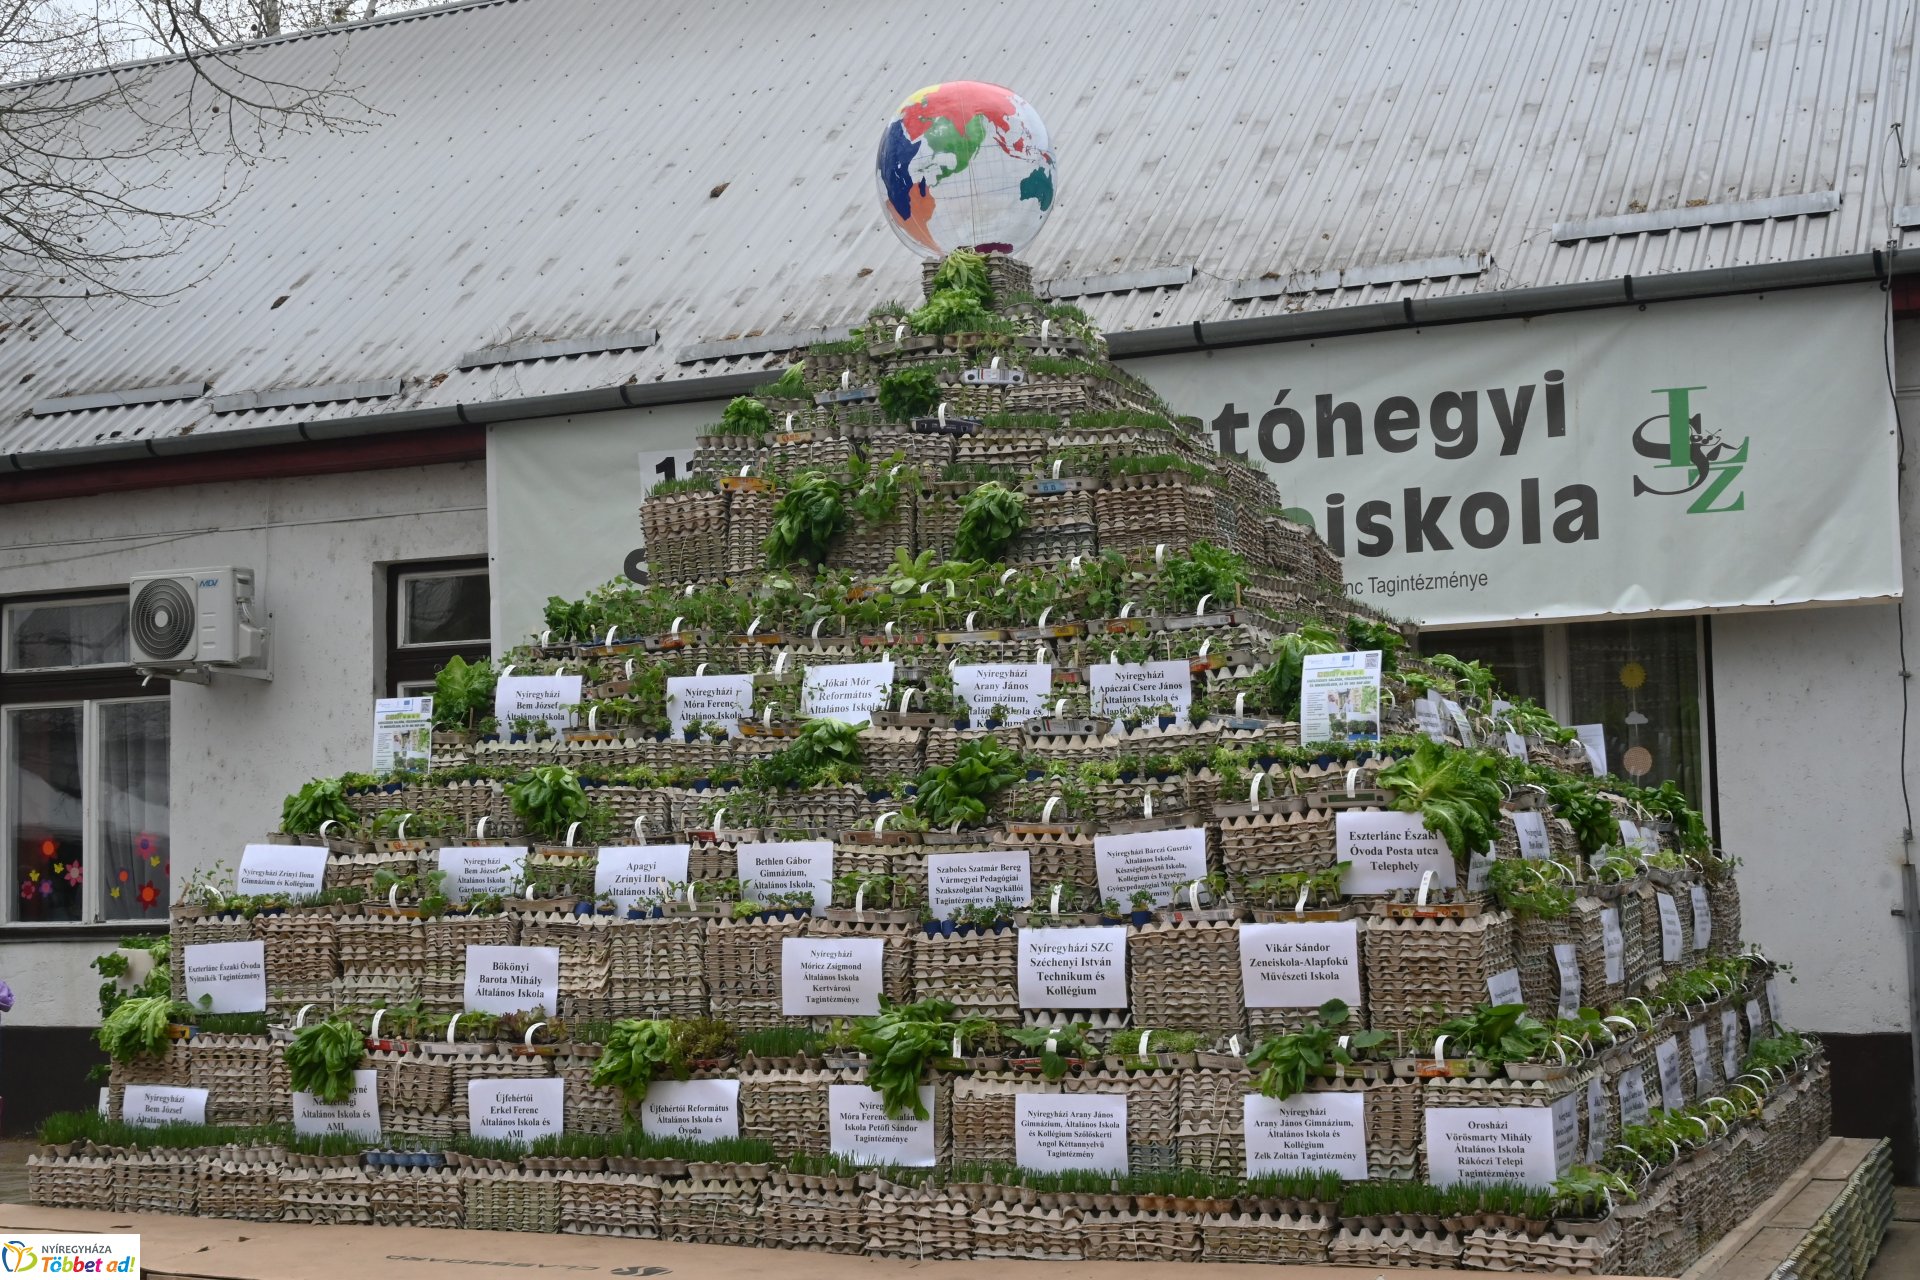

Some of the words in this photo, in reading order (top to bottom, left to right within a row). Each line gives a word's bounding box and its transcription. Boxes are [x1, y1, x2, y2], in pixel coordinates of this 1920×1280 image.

[1186, 369, 1566, 464] tóhegyi
[1281, 474, 1600, 558] iskola
[1367, 570, 1489, 597] Tagintézménye
[977, 669, 1028, 679] Nyíregyházi
[1115, 671, 1164, 682] Nyíregyházi
[823, 677, 848, 687] Jókai
[850, 677, 871, 686] Mór
[974, 682, 999, 691] Arany
[1002, 680, 1029, 689] János
[686, 687, 733, 698] Nyíregyházi
[1099, 683, 1131, 694] Apáczai
[1132, 682, 1157, 691] Csere
[1158, 681, 1183, 690] János
[516, 690, 560, 699] Nyíregyházi
[819, 690, 872, 701] Református
[973, 693, 1029, 703] Gimnázium,
[1143, 693, 1168, 702] Iskola
[1170, 693, 1180, 701] és
[535, 701, 559, 709] József
[684, 700, 705, 709] Móra
[809, 703, 850, 714] Általános
[542, 713, 565, 721] Iskola
[1349, 830, 1402, 841] Eszterlánc
[1107, 849, 1144, 859] Nyíregyházi
[1145, 846, 1166, 856] Bárczi
[1166, 844, 1192, 853] Gusztáv
[1350, 844, 1383, 856] Óvoda
[1385, 846, 1414, 855] Posta
[1416, 847, 1439, 855] utca
[464, 858, 501, 866] Nyíregyházi
[755, 858, 784, 866] Bethlen
[786, 856, 813, 865] Gábor
[1124, 857, 1153, 866] Általános
[626, 862, 656, 872] Apagyi
[936, 866, 967, 874] Szabolcs
[968, 864, 998, 873] Szatmár
[1000, 863, 1022, 872] Bereg
[1369, 861, 1420, 872] Telephely
[243, 868, 277, 878] Nyíregyházi
[278, 870, 298, 878] Zrínyi
[299, 871, 315, 879] Ilona
[760, 869, 807, 877] Gimnázium,
[1118, 873, 1150, 883] Kollégium
[1158, 870, 1186, 881] Egységes
[241, 877, 275, 886] Gimnázium
[285, 879, 315, 888] Kollégium
[457, 875, 486, 883] Általános
[615, 874, 642, 884] Zrínyi
[753, 879, 787, 889] Általános
[789, 880, 816, 889] Iskola,
[940, 875, 978, 885] Vármegyei
[980, 874, 1019, 883] Pedagógiai
[935, 885, 983, 895] Szakszolgálat
[985, 883, 1024, 894] Nagykállói
[1106, 881, 1160, 893] Gyógypedagógiai
[934, 896, 984, 905] Tagintézmény
[1030, 942, 1088, 955] Nyíregyházi
[1090, 942, 1114, 952] SZC
[1265, 943, 1293, 953] Vikár
[1295, 942, 1331, 952] Sándor
[810, 949, 853, 959] Nyíregyházi
[188, 964, 219, 973] Eszterlánc
[219, 961, 240, 971] Északi
[240, 960, 261, 970] Óvoda
[492, 961, 529, 973] Bökönyi
[800, 961, 825, 970] Móricz
[826, 962, 862, 971] Zsigmond
[1030, 957, 1078, 969] Széchenyi
[1080, 956, 1112, 967] István
[1249, 956, 1349, 968] Zeneiskola-Alapfokú
[218, 972, 260, 982] Tagintézmény
[479, 974, 508, 984] Barota
[510, 975, 543, 987] Mihály
[803, 971, 836, 981] Általános
[837, 973, 860, 981] Iskola
[1036, 971, 1093, 981] Technikum
[1095, 971, 1106, 981] és
[1260, 972, 1308, 981] Művészeti
[1310, 971, 1340, 981] Iskola
[475, 984, 516, 998] Általános
[517, 988, 545, 998] Iskola
[812, 984, 851, 992] Kertvárosi
[1046, 985, 1097, 998] Kollégium
[805, 995, 860, 1005] Tagintézménye
[144, 1093, 185, 1103] Nyíregyházi
[495, 1091, 533, 1104] Újfehértói
[145, 1104, 160, 1113] Bem
[161, 1105, 184, 1114] József
[301, 1107, 336, 1119] Általános
[337, 1109, 361, 1118] Iskola
[362, 1109, 371, 1118] és
[490, 1105, 512, 1114] Erkel
[513, 1106, 539, 1114] Ferenc
[649, 1103, 686, 1114] Újfehértói
[687, 1103, 729, 1112] Református
[1280, 1107, 1327, 1118] Nyíregyházi
[657, 1113, 690, 1124] Általános
[691, 1115, 713, 1123] Iskola
[714, 1115, 723, 1123] és
[840, 1112, 860, 1121] Móra
[861, 1112, 888, 1121] Ferenc
[1028, 1110, 1069, 1119] Nyíregyházi
[1070, 1111, 1091, 1120] Arany
[1093, 1111, 1114, 1119] János
[480, 1115, 516, 1126] Általános
[517, 1117, 540, 1126] Iskola
[542, 1117, 551, 1126] és
[1020, 1120, 1063, 1129] Gimnázium,
[1064, 1119, 1097, 1128] Általános
[1098, 1121, 1120, 1129] Iskola
[1254, 1119, 1277, 1129] Arany
[1279, 1119, 1303, 1128] János
[1304, 1118, 1354, 1128] Gimnázium,
[1467, 1120, 1508, 1130] Orosházi
[326, 1122, 346, 1131] AMI
[678, 1124, 703, 1134] Óvoda
[845, 1123, 868, 1132] Iskola
[868, 1122, 890, 1132] Petőfi
[891, 1123, 919, 1132] Sándor
[507, 1129, 524, 1138] AMI
[1028, 1130, 1036, 1138] és
[1037, 1130, 1073, 1139] Kollégium
[1074, 1130, 1112, 1139] Szőlőskerti
[1267, 1128, 1304, 1138] Általános
[1306, 1129, 1330, 1138] Iskola
[1332, 1129, 1341, 1138] és
[1445, 1132, 1498, 1143] Vörösmarty
[1500, 1132, 1533, 1143] Mihály
[853, 1134, 909, 1144] Tagintézménye
[1036, 1140, 1057, 1149] Angol
[1058, 1140, 1105, 1150] Kéttannyelvű
[1284, 1141, 1325, 1150] Kollégium
[1455, 1143, 1496, 1154] Általános
[1498, 1145, 1526, 1154] Iskola
[1047, 1150, 1095, 1160] Tagintézmény
[1254, 1151, 1272, 1160] Zelk
[1273, 1151, 1299, 1160] Zoltán
[1301, 1151, 1357, 1161] Tagintézmény
[1457, 1156, 1494, 1165] Rákóczi
[1495, 1157, 1524, 1167] Telepi
[1458, 1169, 1526, 1179] Tagintézménye
